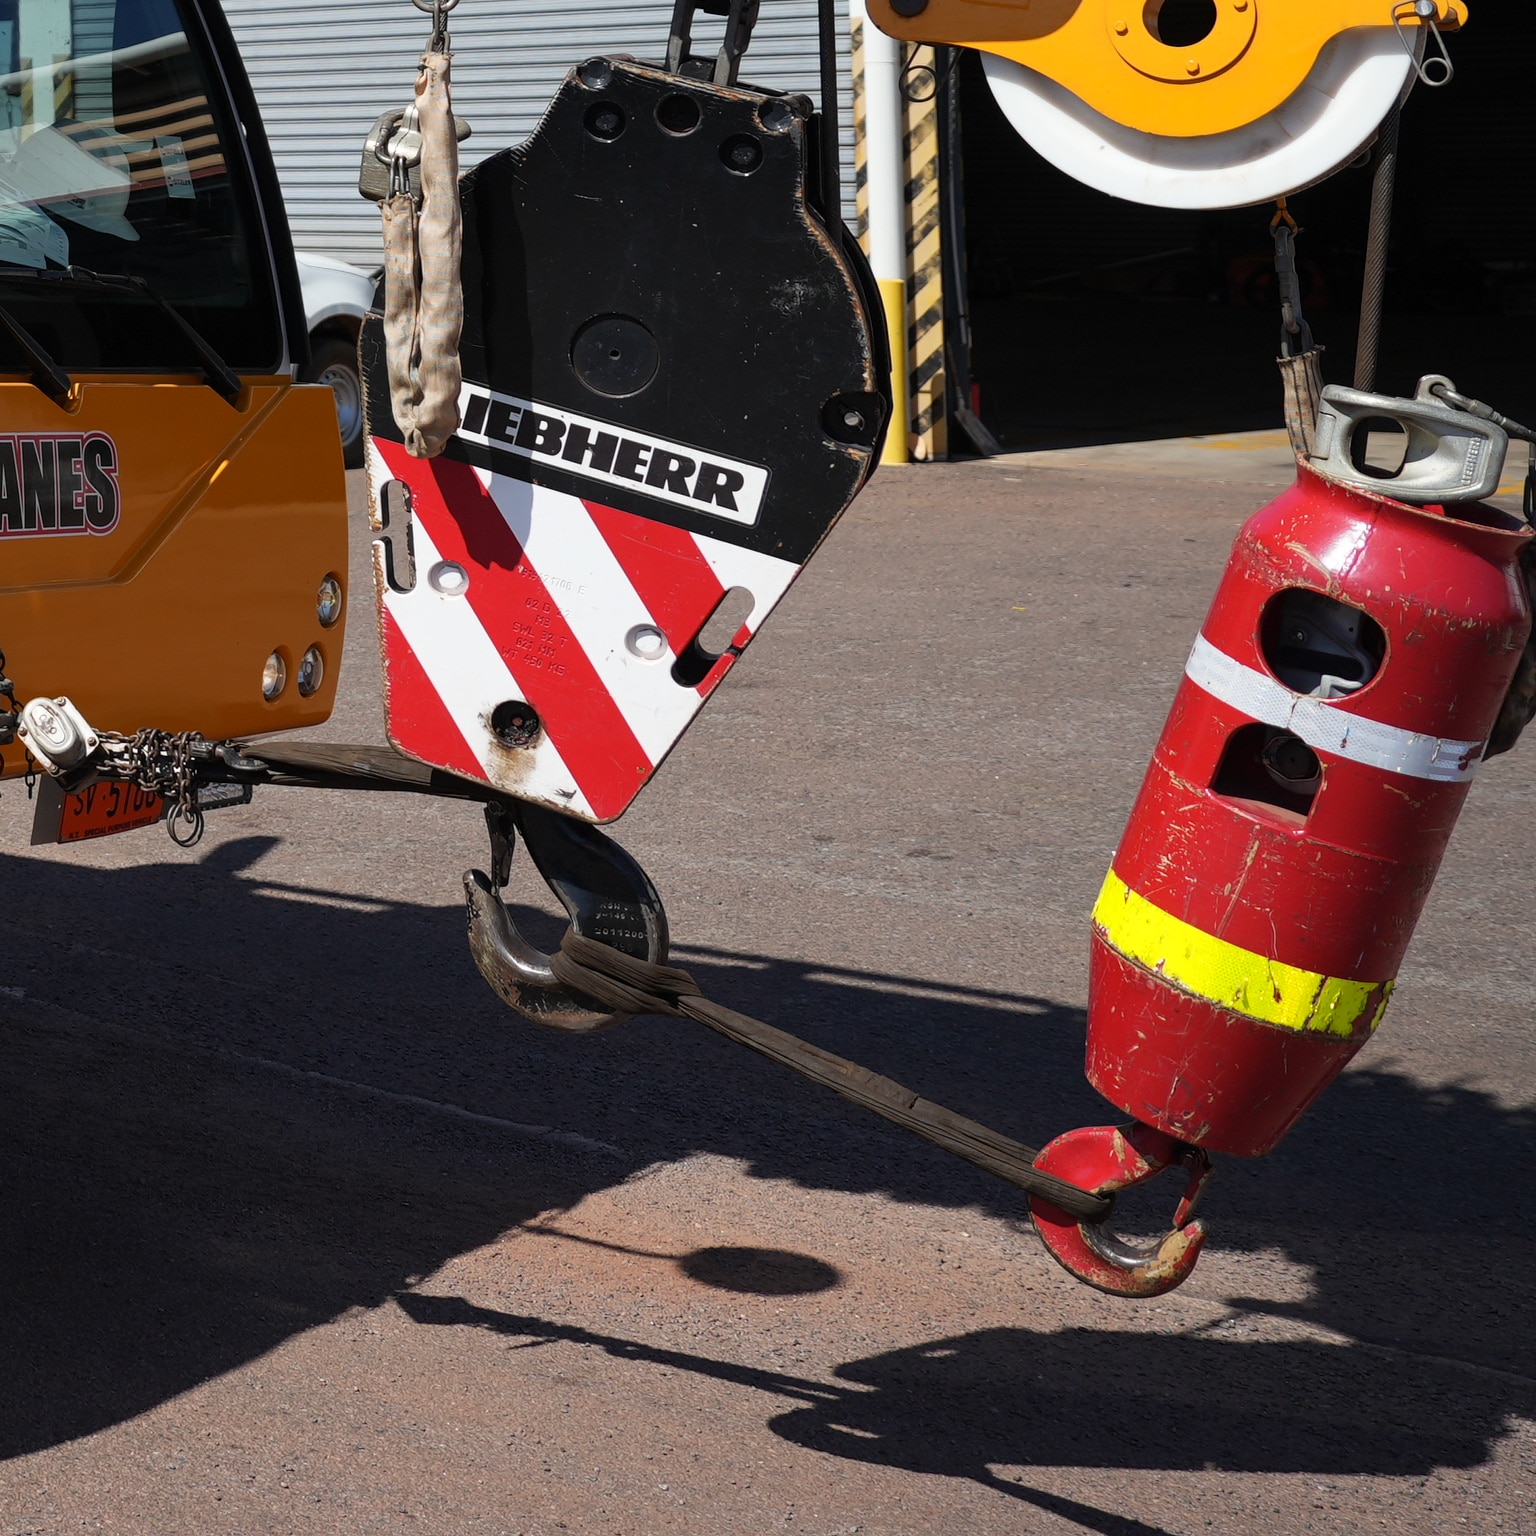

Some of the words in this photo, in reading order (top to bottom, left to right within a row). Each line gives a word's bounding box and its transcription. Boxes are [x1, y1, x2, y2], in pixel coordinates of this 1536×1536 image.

[459, 393, 745, 513] IEBHERR
[513, 621, 536, 638] SWL
[559, 636, 569, 648] T
[501, 646, 519, 660] WT
[537, 644, 557, 659] MM
[84, 825, 107, 838] SPECIAL
[107, 820, 132, 834] PURPOSE
[131, 815, 153, 828] VEHICLE
